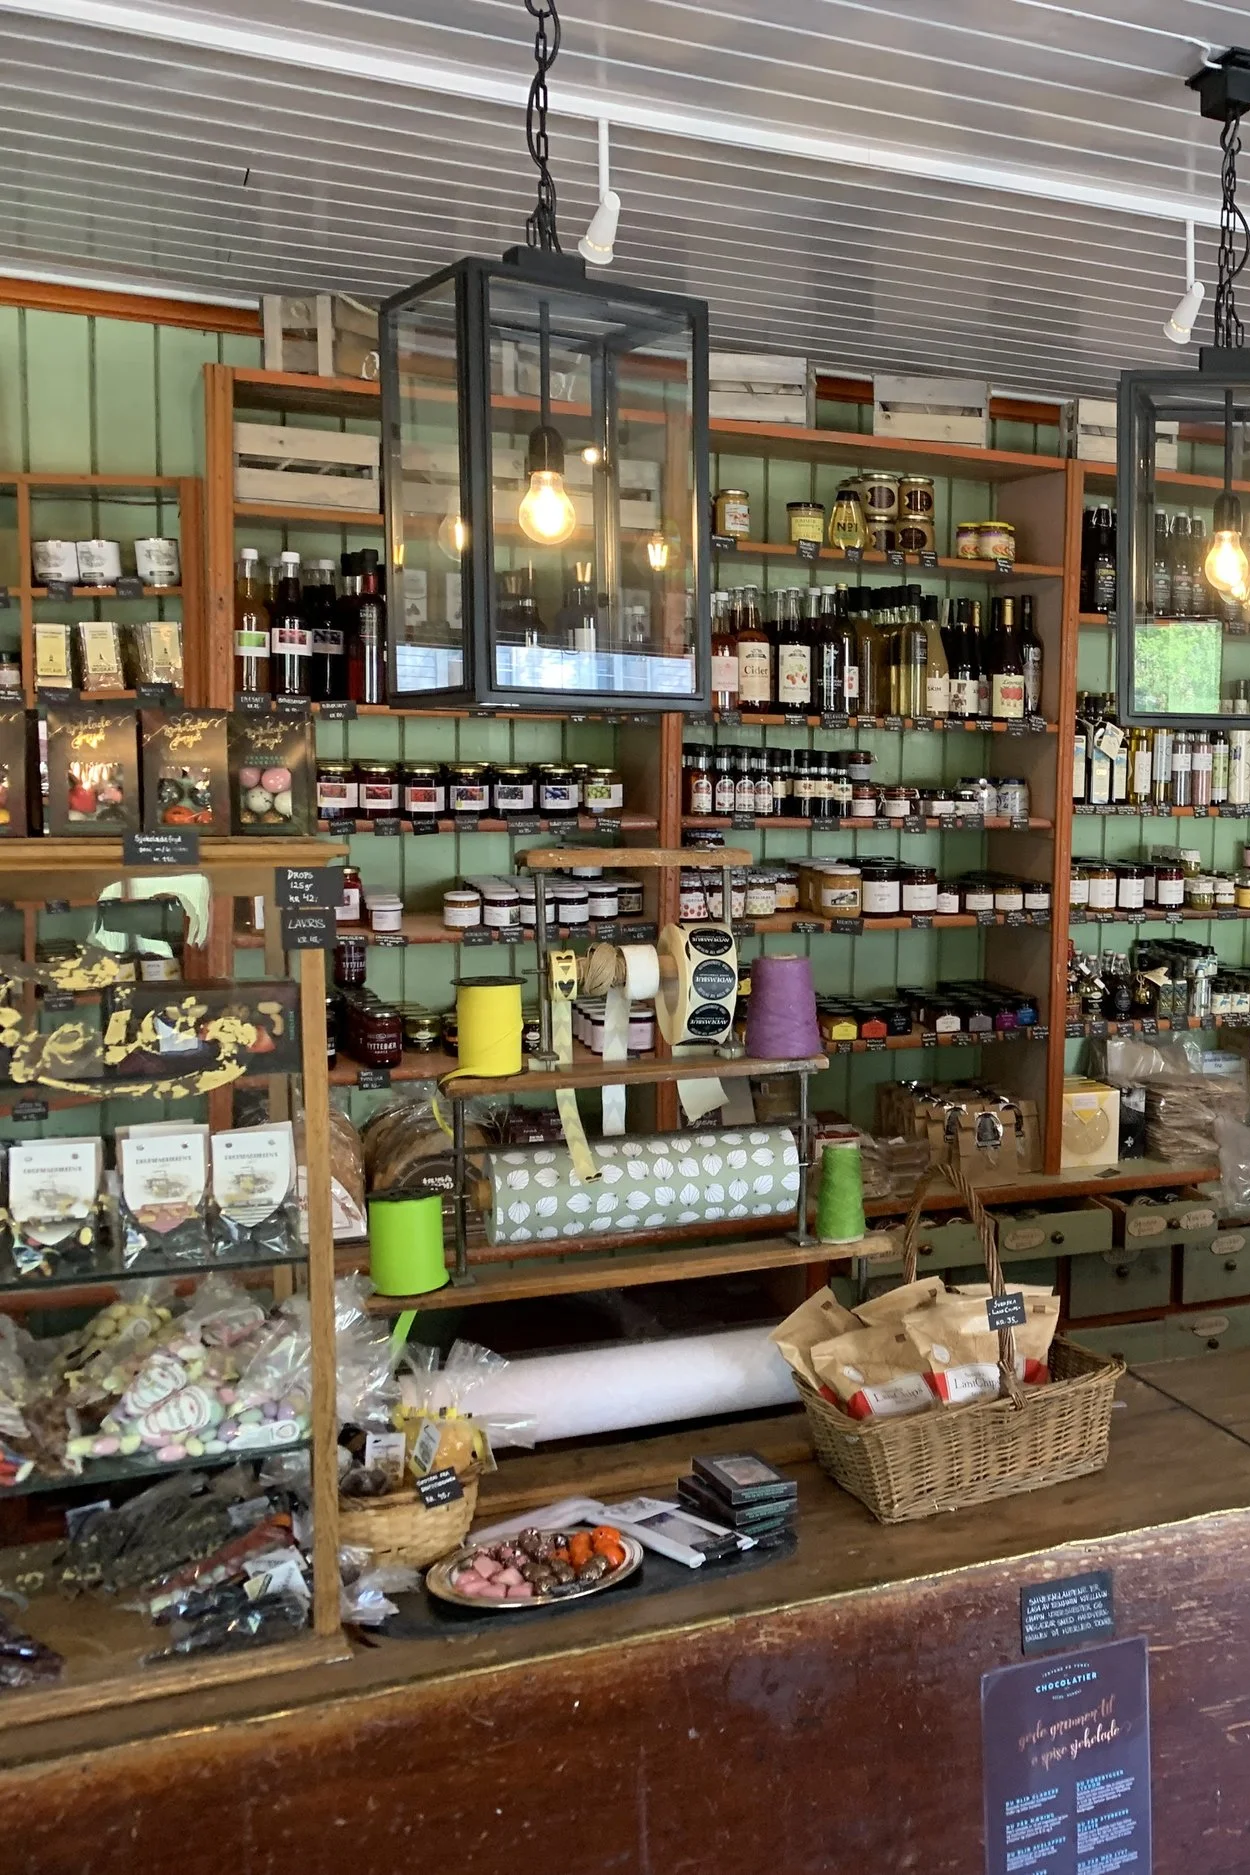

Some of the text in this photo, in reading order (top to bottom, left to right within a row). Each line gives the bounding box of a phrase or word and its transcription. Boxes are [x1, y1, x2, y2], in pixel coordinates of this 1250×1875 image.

[744, 665, 768, 675] Cider
[287, 869, 314, 880] DROPS
[366, 1041, 397, 1050] TYTTEBÆR
[1035, 1671, 1098, 1694] CHOCOLATIER
[1070, 1718, 1121, 1761] sjokolade
